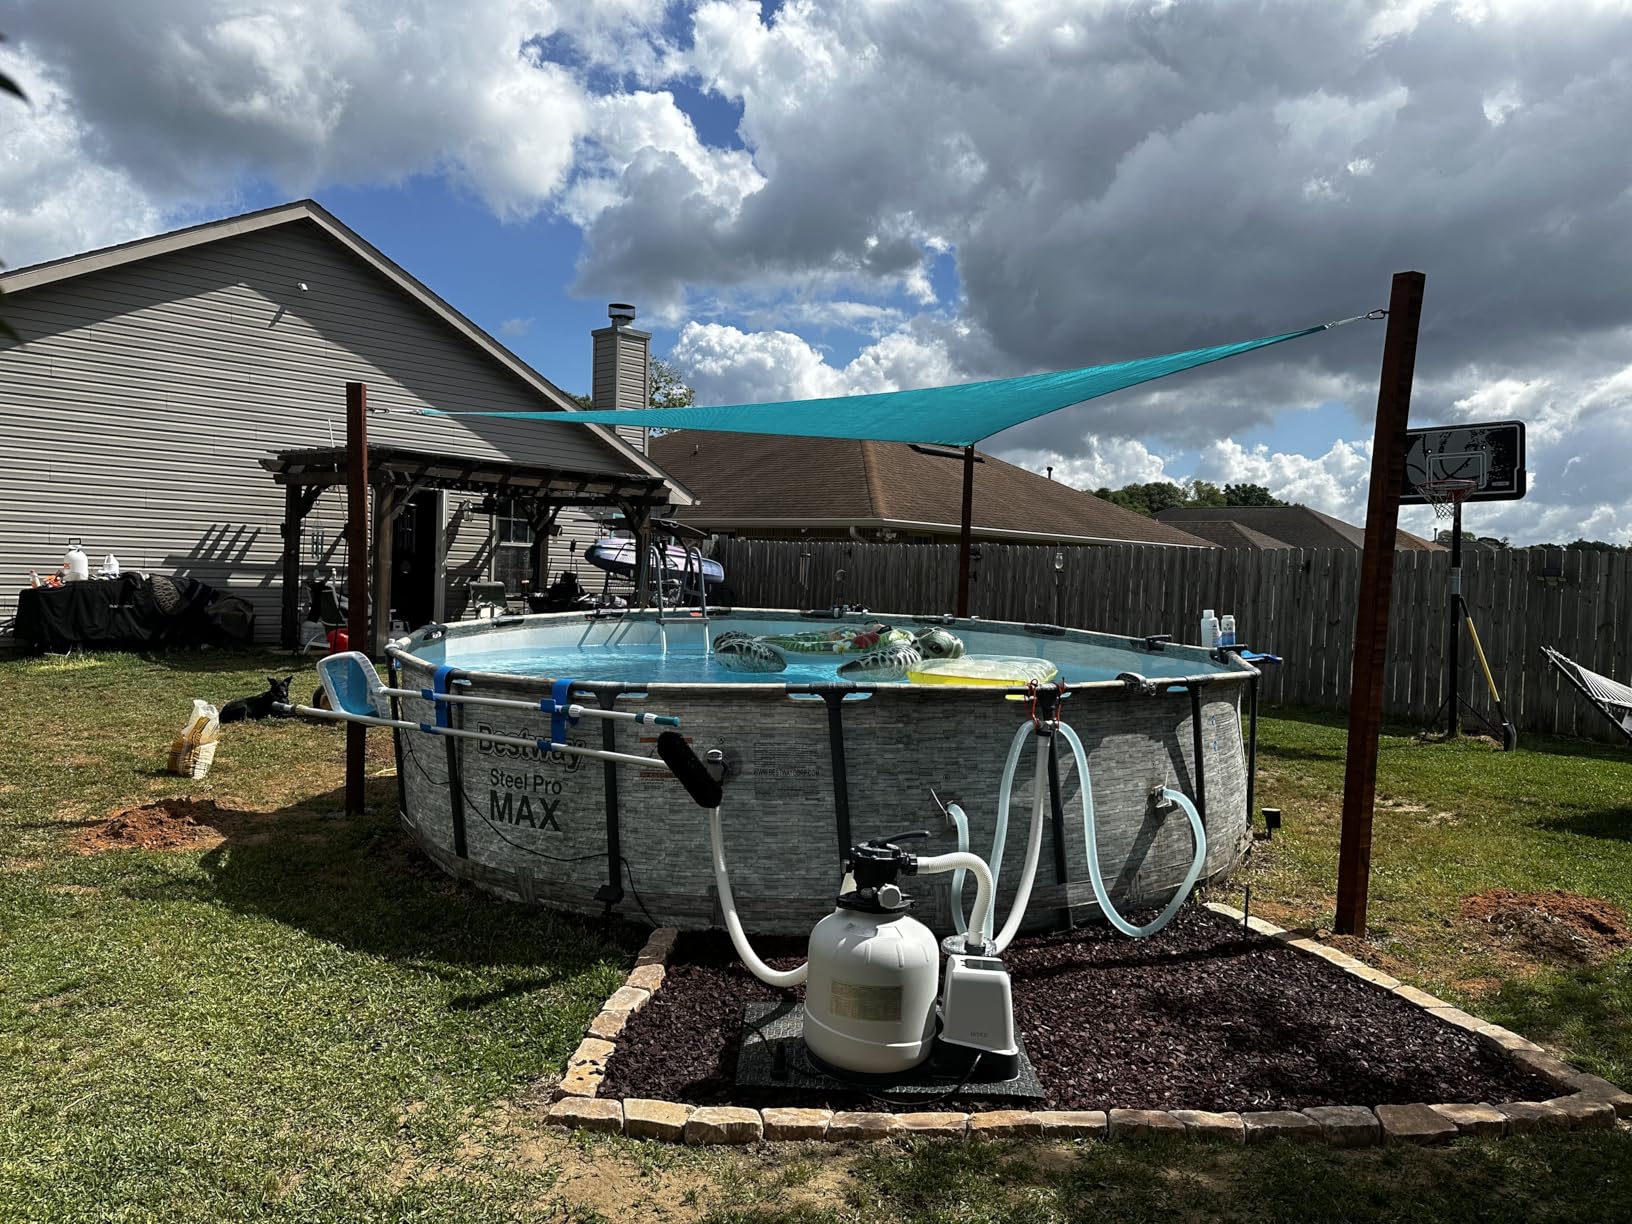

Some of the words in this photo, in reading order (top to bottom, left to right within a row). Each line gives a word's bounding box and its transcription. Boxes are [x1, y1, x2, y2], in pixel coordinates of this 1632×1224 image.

[490, 768, 528, 790] Steel
[533, 774, 562, 795] Pro
[490, 790, 561, 832] MAX
